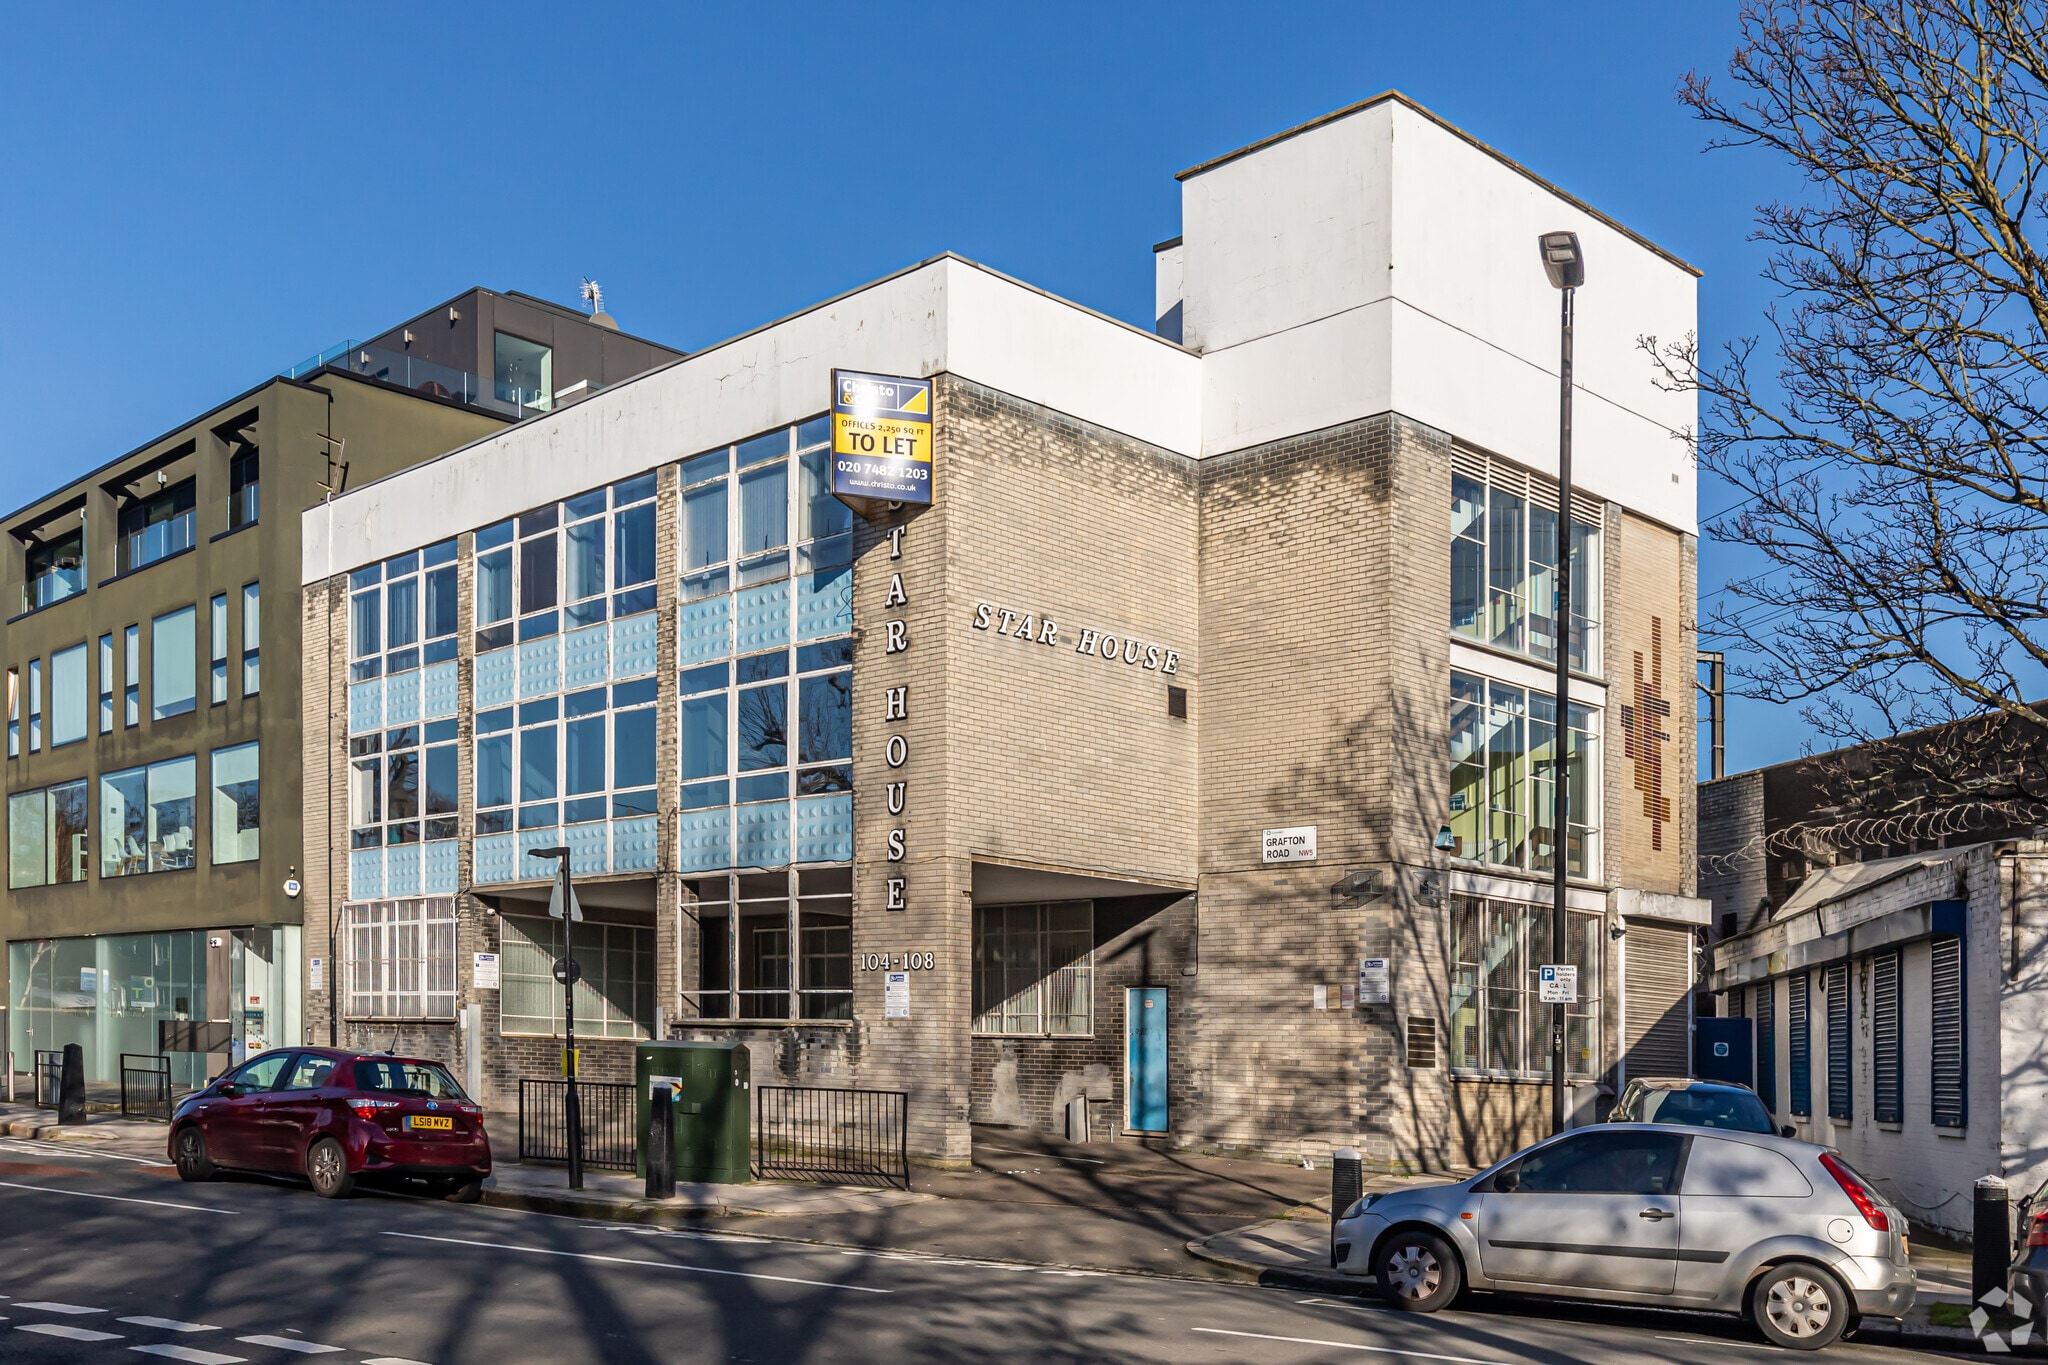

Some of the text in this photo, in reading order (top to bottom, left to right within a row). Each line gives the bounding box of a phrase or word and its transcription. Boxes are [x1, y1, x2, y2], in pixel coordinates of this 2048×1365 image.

[841, 419, 876, 431] OFFICES
[878, 425, 901, 434] 2,250
[849, 432, 918, 456] TO LET
[838, 460, 928, 480] 020 7482 1203
[849, 479, 917, 492] www.christo.co.uk
[973, 603, 1181, 675] STAR HOUSE
[884, 685, 910, 911] HOUSE
[1266, 836, 1306, 847] GRAFTON
[1266, 849, 1313, 859] ROAD NW5
[861, 951, 935, 971] 104-108
[1544, 969, 1553, 980] P
[413, 1117, 449, 1129] LS18 MVZ
